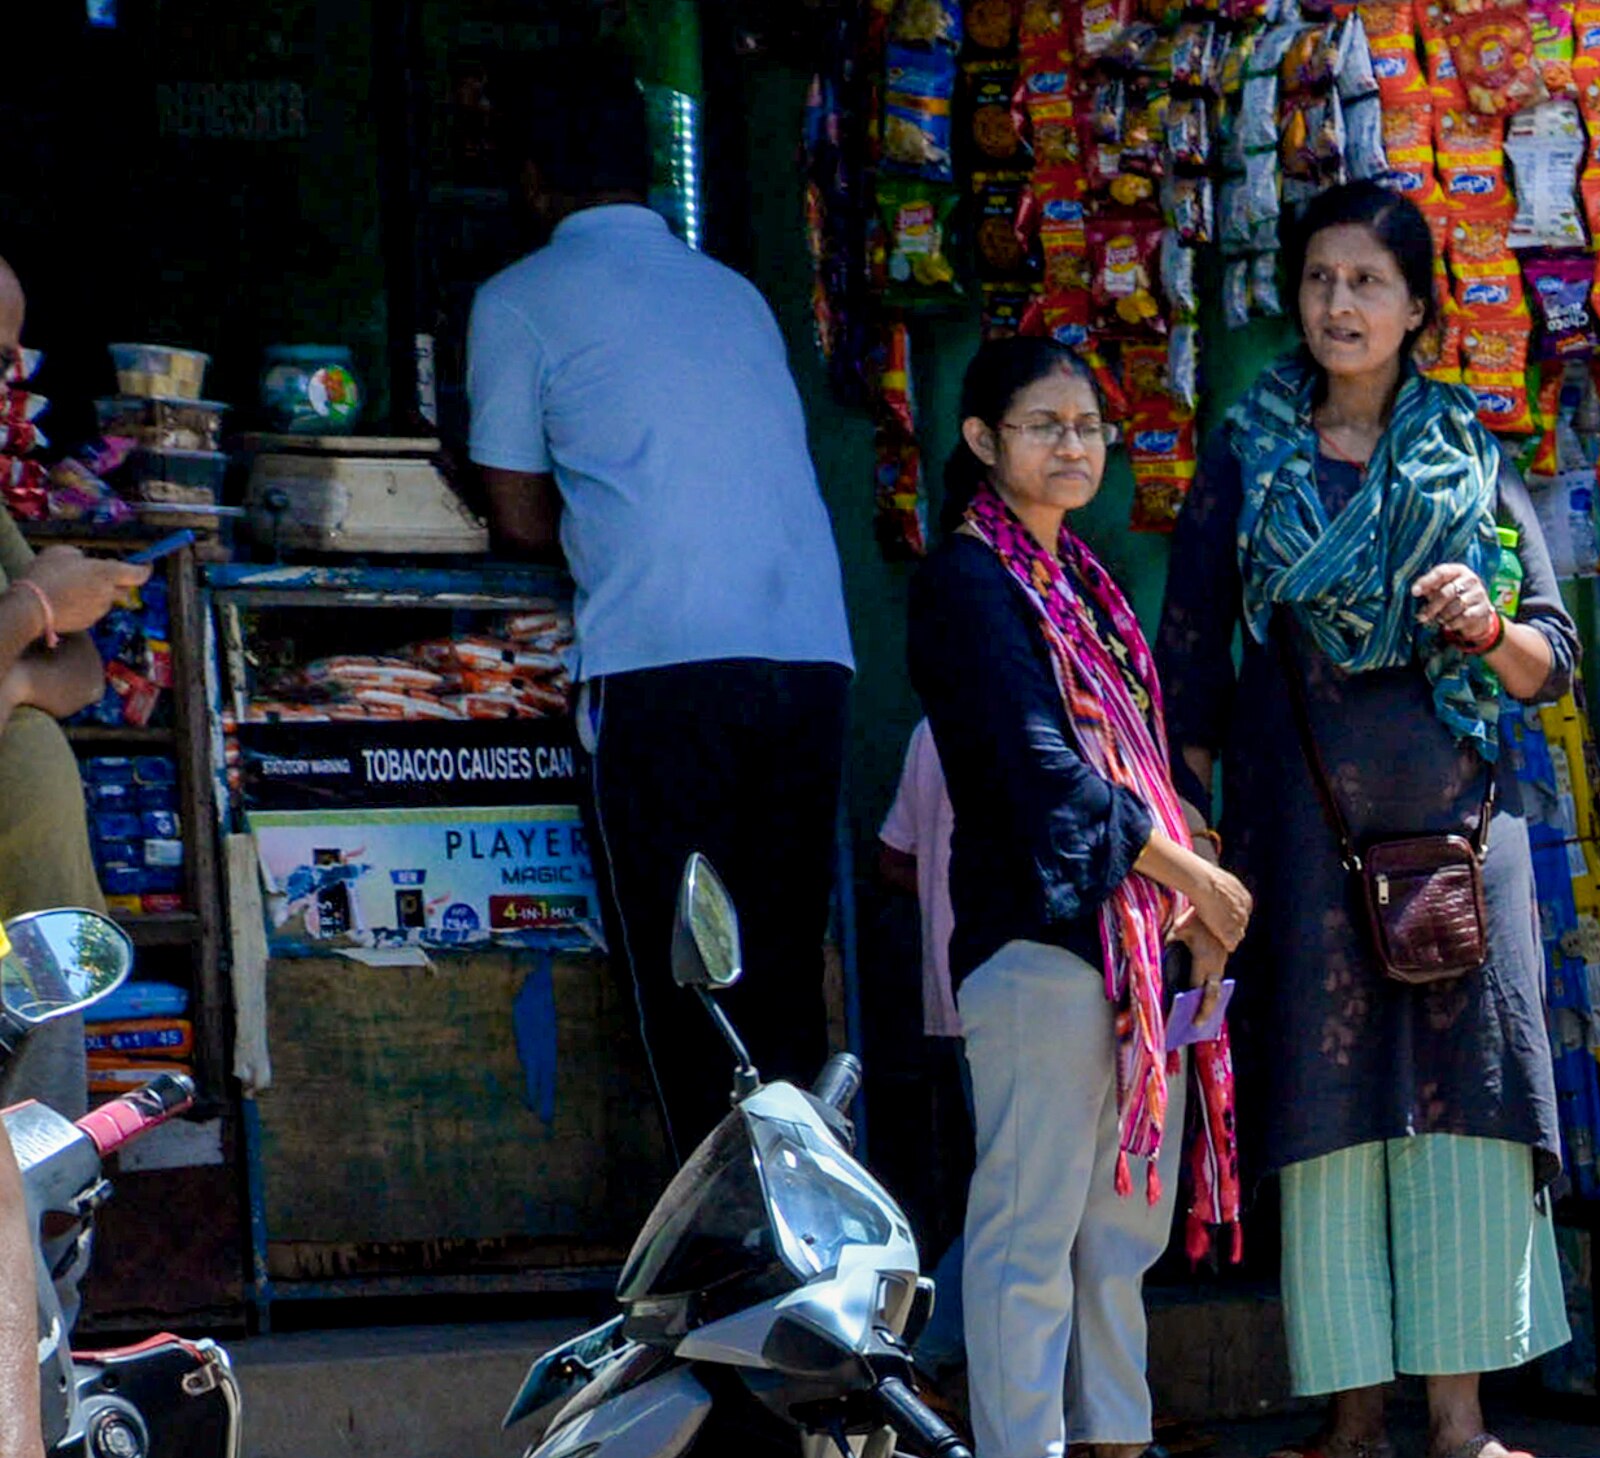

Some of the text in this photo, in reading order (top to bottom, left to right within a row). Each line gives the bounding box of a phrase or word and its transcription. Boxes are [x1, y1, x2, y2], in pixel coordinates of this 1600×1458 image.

[262, 747, 574, 782] STATUTORY WARNING TOBACCO CAUSES CAN
[445, 827, 588, 860] PLAYER
[501, 866, 573, 885] MAGIC
[551, 906, 576, 919] MIX
